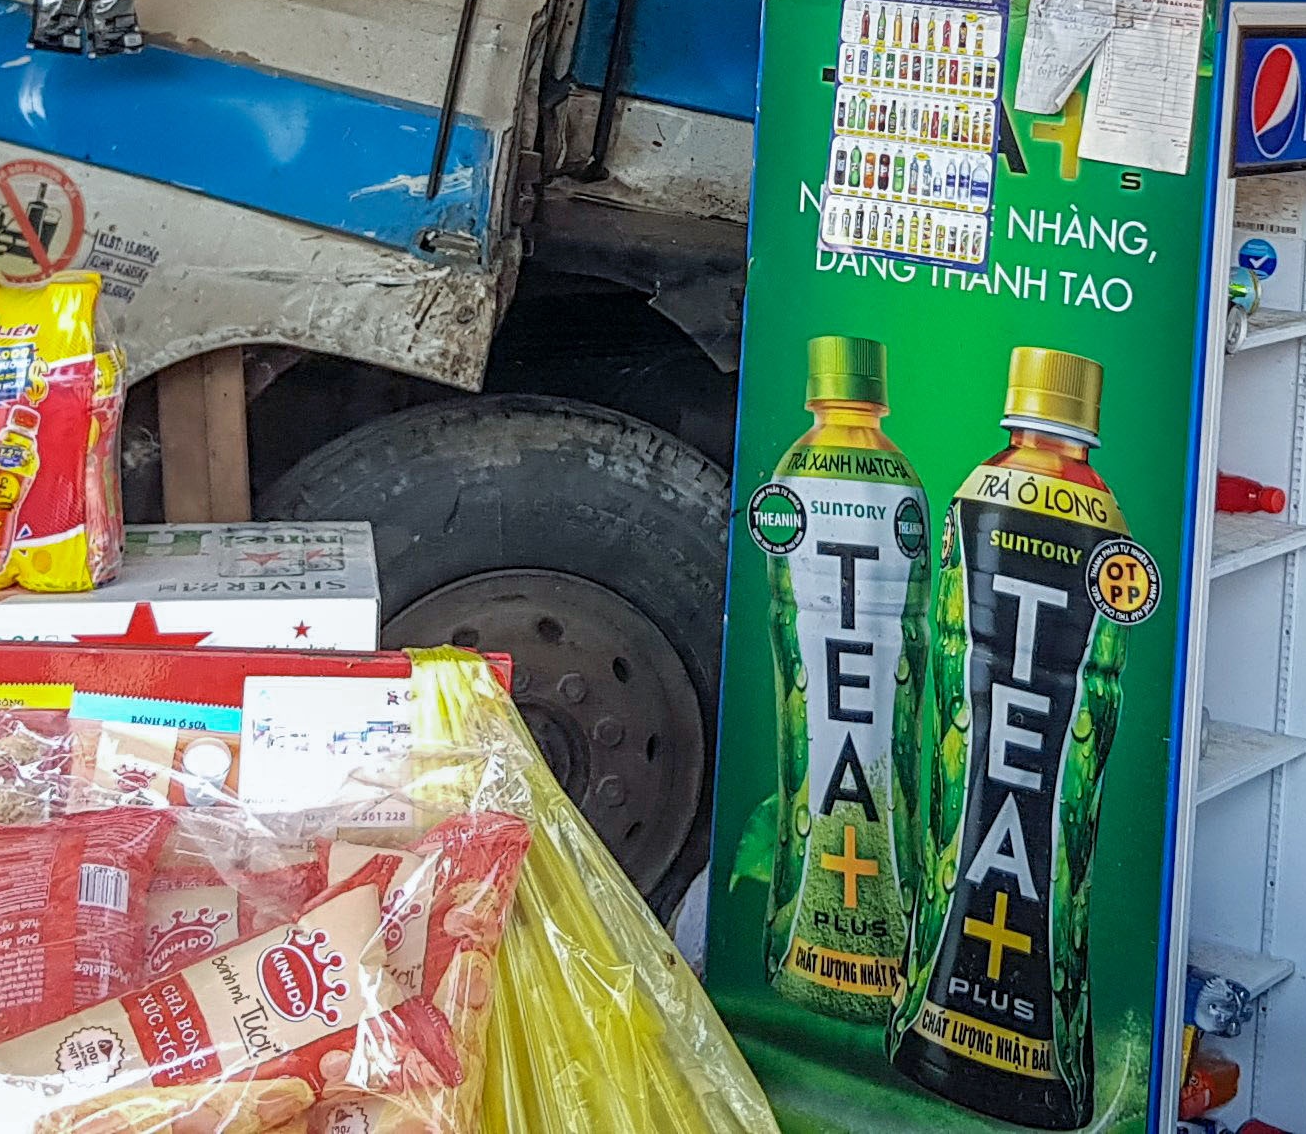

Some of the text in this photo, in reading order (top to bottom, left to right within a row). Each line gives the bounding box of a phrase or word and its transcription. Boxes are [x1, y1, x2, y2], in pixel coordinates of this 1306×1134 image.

[1008, 202, 1158, 265] NHÀNG,
[1059, 271, 1134, 313] TAO
[808, 453, 851, 475] XANH
[855, 456, 912, 479] MATCHA
[810, 499, 887, 521] SUNTORY
[976, 471, 1108, 524] TRÀ Ô LONG
[753, 510, 803, 529] THEANIN
[989, 529, 1083, 566] SUNTORY
[1106, 561, 1138, 581] OT
[1110, 585, 1141, 604] PP
[814, 910, 888, 938] PLUS
[795, 946, 818, 974] CHẤT
[820, 955, 858, 987] LƯỢNG
[859, 959, 888, 993] NHẬT
[137, 993, 164, 1027] XÚC
[160, 983, 190, 1017] CHÀ
[947, 976, 1035, 1022] PLUS
[920, 1008, 1030, 1071] CHẤT LƯỢNG NHẬT
